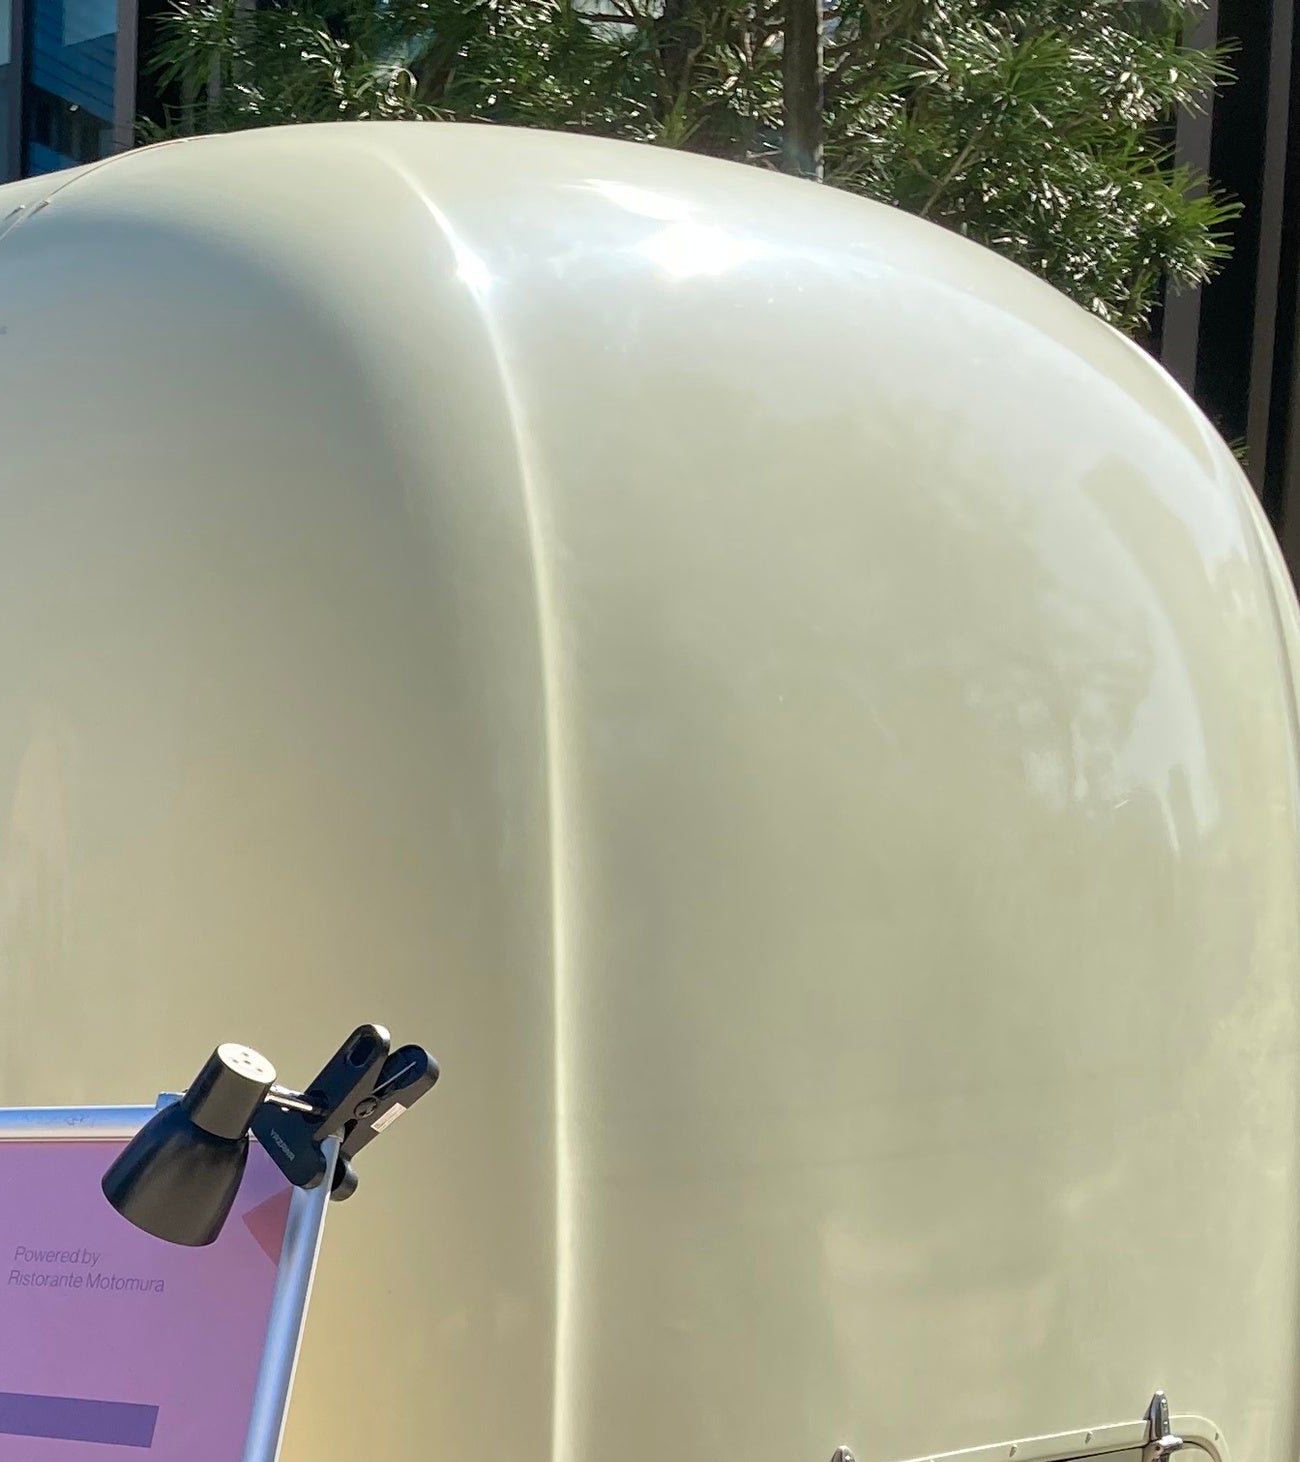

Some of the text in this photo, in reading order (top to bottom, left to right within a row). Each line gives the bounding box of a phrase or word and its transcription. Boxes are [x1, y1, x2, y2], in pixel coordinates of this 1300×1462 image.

[13, 1245, 100, 1267] Powered by
[7, 1269, 166, 1293] Ristorante Motomura
